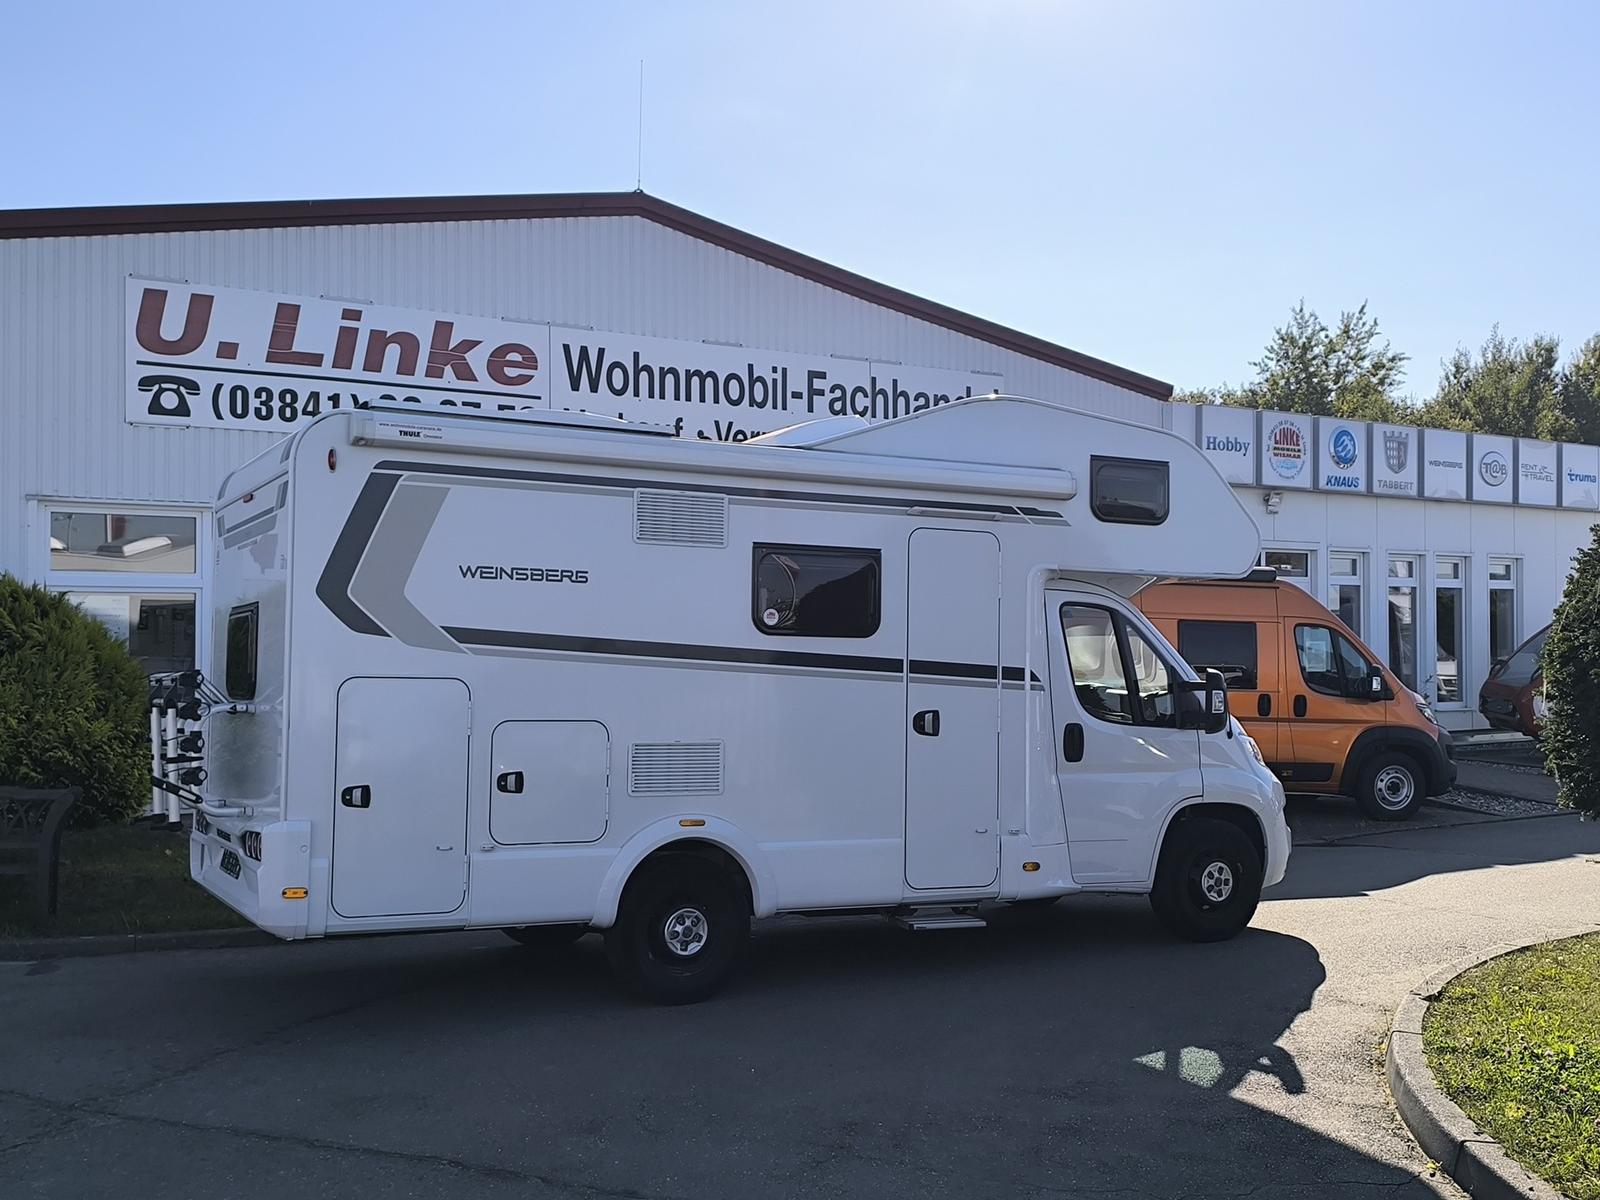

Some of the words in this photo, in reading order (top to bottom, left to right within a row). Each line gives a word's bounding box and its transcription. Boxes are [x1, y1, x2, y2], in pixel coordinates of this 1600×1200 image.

[136, 288, 239, 359] U.
[265, 302, 539, 386] Linke
[562, 343, 999, 420] Wohnmobil-Fachha
[1206, 436, 1251, 457] Hobby
[1274, 427, 1301, 447] LINKE
[1326, 475, 1360, 488] KNAUS
[1377, 479, 1414, 490] TABBERT
[1530, 473, 1554, 482] TRAVEL
[1568, 469, 1597, 483] truma
[459, 565, 589, 584] WEINSBERG
